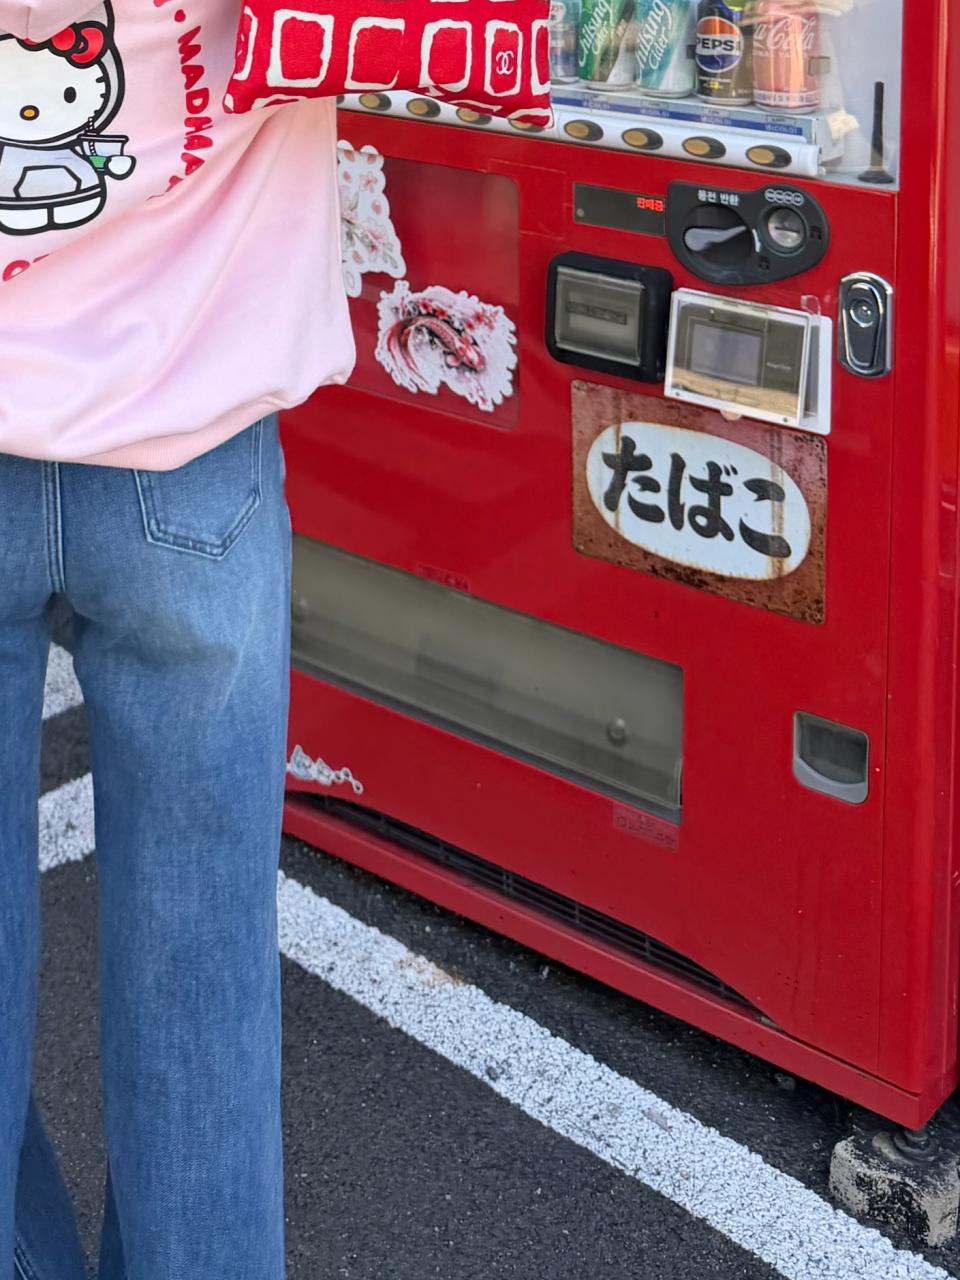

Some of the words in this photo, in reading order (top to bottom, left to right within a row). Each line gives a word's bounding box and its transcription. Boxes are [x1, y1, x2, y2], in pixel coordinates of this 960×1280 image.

[648, 26, 670, 70] Cider
[601, 435, 792, 559] たばこ
